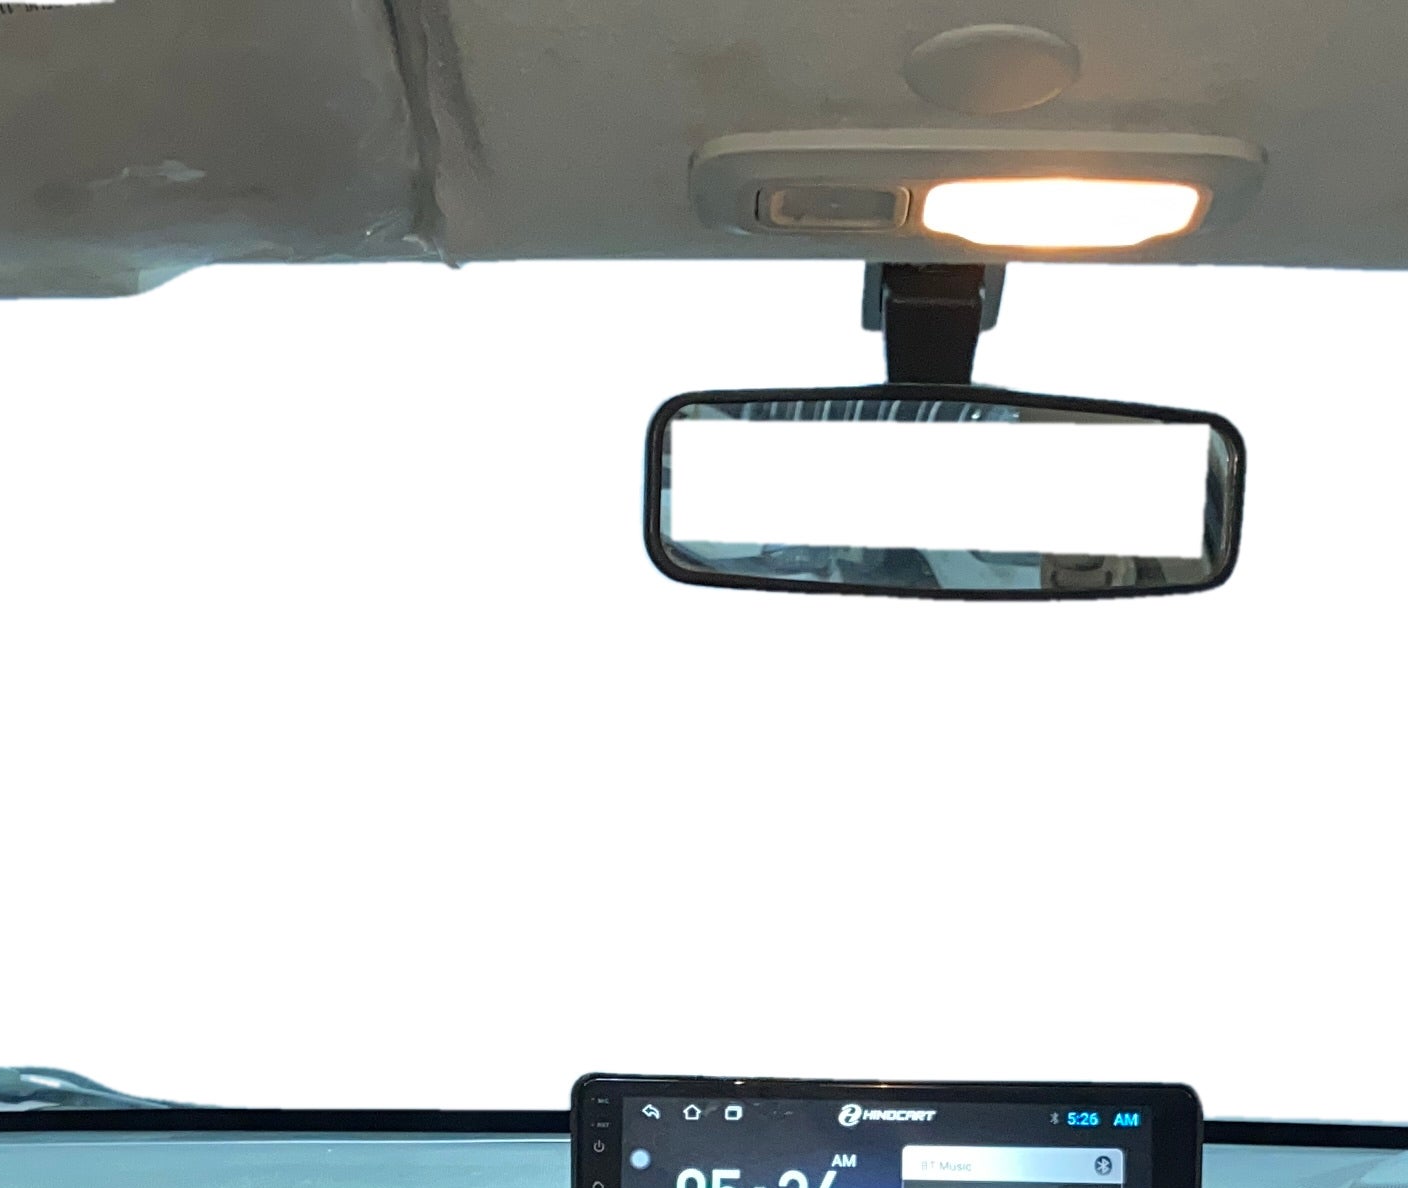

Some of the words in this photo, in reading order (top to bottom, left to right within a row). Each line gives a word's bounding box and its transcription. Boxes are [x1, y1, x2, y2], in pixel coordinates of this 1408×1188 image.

[863, 1109, 937, 1121] HINDCART
[1067, 1112, 1099, 1126] 5:26
[1113, 1112, 1139, 1127] AM
[831, 1154, 857, 1168] AM
[939, 1161, 973, 1173] Music
